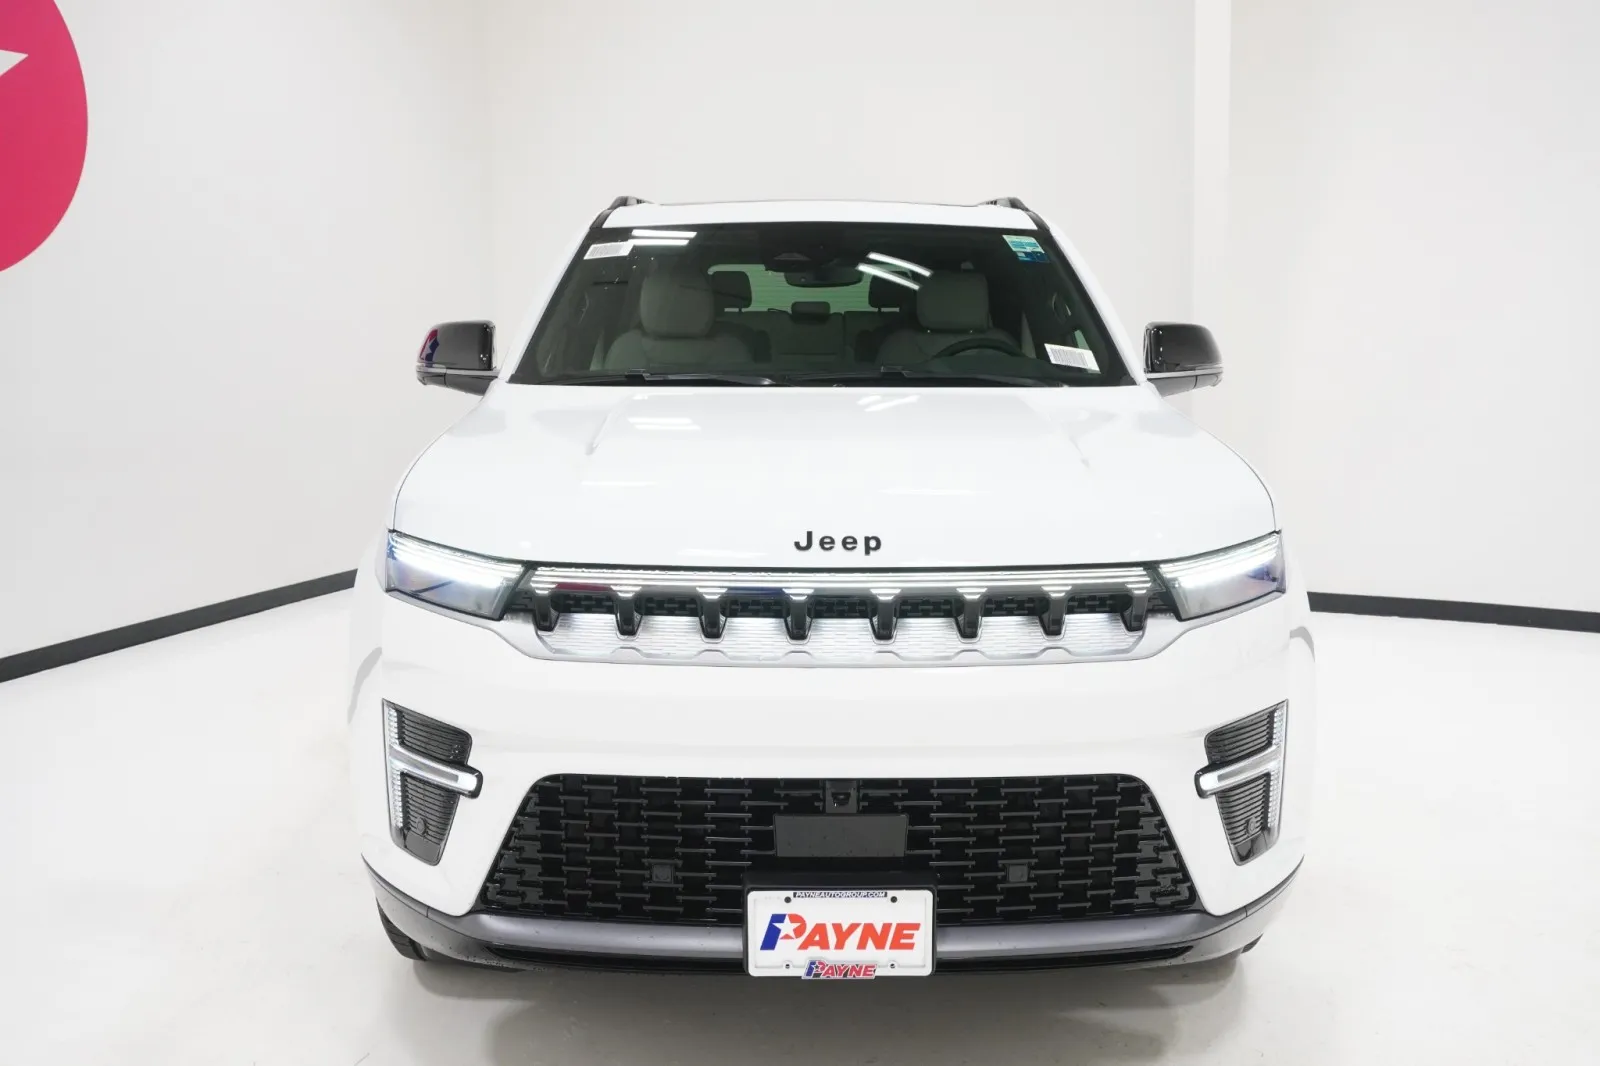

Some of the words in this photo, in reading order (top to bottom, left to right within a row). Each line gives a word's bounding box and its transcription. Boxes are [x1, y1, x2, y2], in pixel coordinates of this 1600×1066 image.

[794, 531, 882, 556] Jeep
[760, 913, 921, 951] PAYNE
[804, 960, 876, 978] PAYNE
